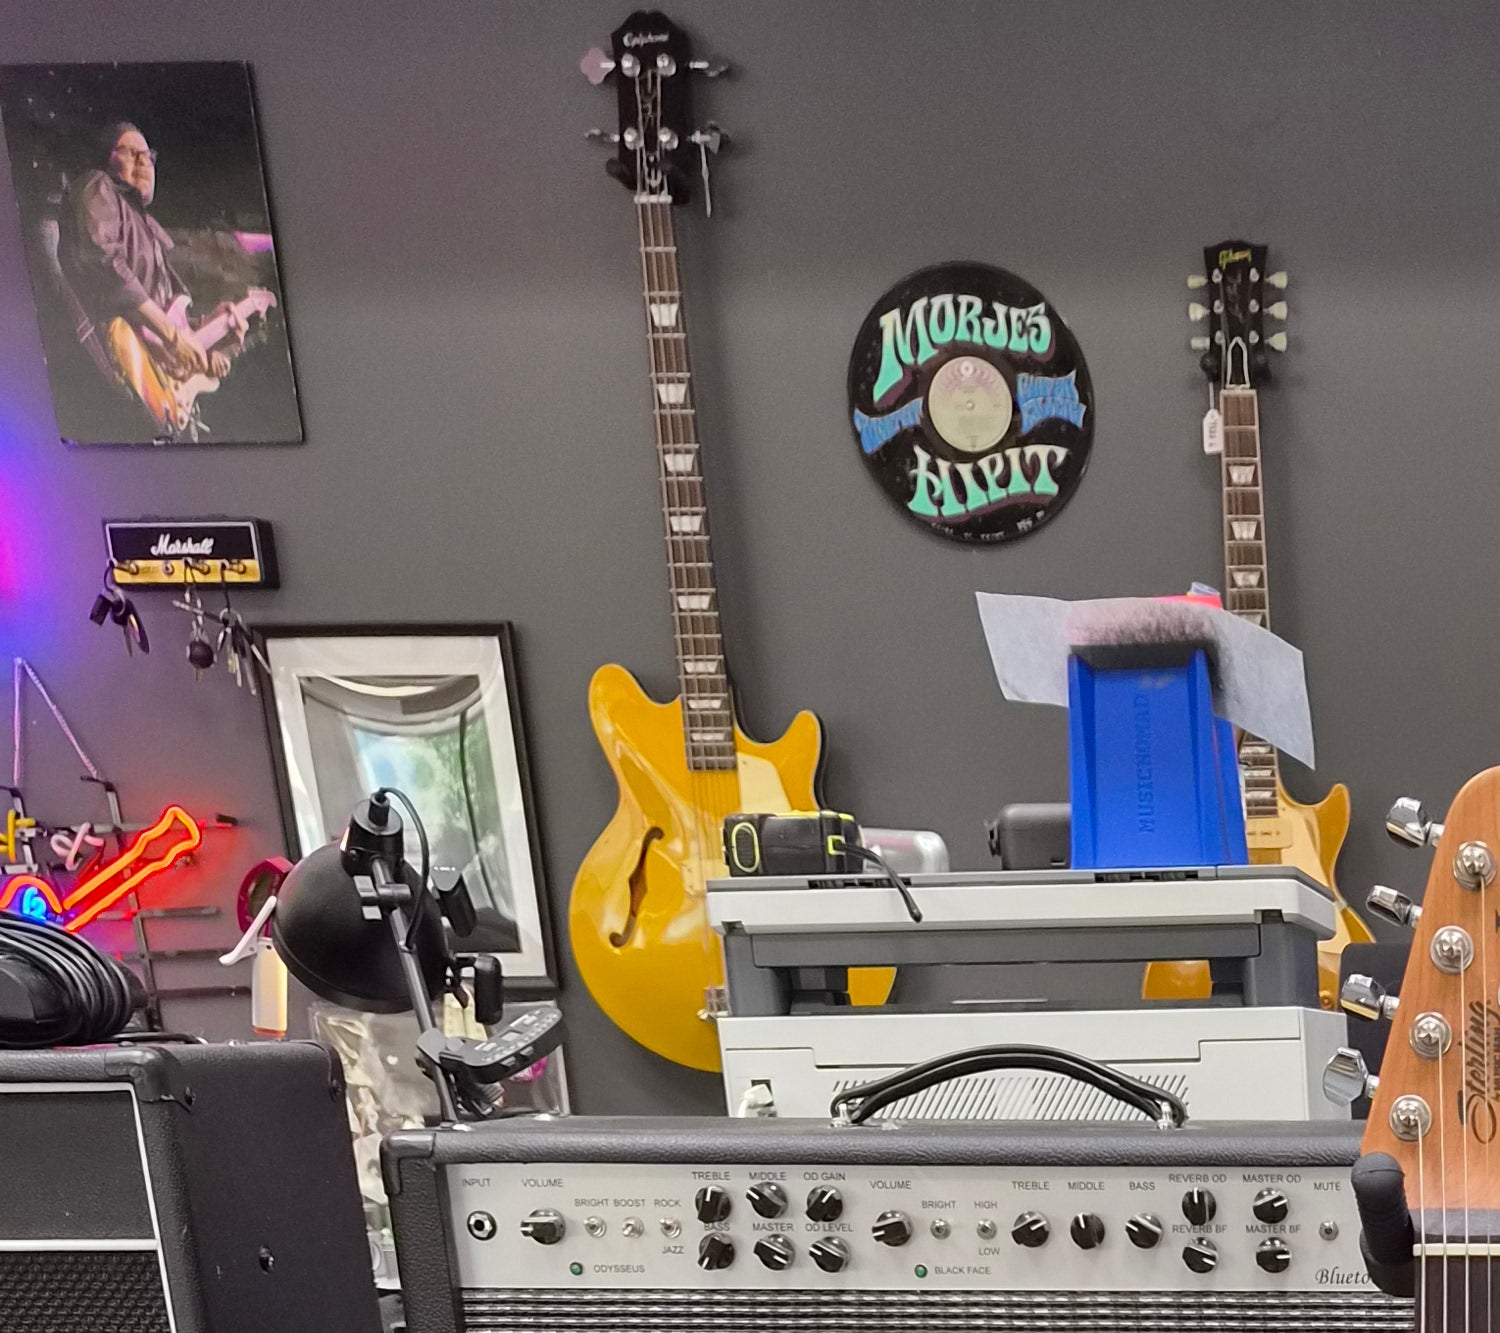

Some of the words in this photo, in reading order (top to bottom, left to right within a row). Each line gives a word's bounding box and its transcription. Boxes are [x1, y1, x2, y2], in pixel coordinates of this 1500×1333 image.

[873, 293, 1051, 406] MORJES
[907, 444, 1069, 518] HIPIT
[150, 533, 215, 556] Marshall
[692, 1171, 731, 1181] TREBLE
[749, 1171, 787, 1181] MIDDLE
[820, 1171, 846, 1181] GAIN
[1168, 1173, 1209, 1184] REVERB
[1242, 1173, 1282, 1184] MASTER
[462, 1178, 491, 1188] INPUT
[521, 1178, 564, 1188] VOLUME
[869, 1180, 912, 1190] VOLUME
[1011, 1181, 1050, 1191] TREBLE
[1068, 1181, 1105, 1191] MIDDLE
[1129, 1181, 1156, 1191] BASS
[1313, 1181, 1341, 1191] MUTE
[574, 1198, 609, 1208] BRIGHT
[613, 1198, 646, 1208] BOOST
[654, 1198, 682, 1208] ROCK
[921, 1200, 956, 1210] BRIGHT
[974, 1200, 998, 1210] HIGH
[704, 1222, 731, 1232] BASS
[752, 1222, 794, 1232] MASTER
[822, 1223, 853, 1233] LEVEL
[1172, 1224, 1213, 1234] REVERB
[662, 1245, 684, 1255] JAZZ
[978, 1247, 1000, 1256] LOW
[593, 1264, 646, 1273] ODYSSEUS
[934, 1266, 965, 1275] BLACK
[967, 1266, 991, 1275] FACE
[1315, 1268, 1371, 1285] Blueto
